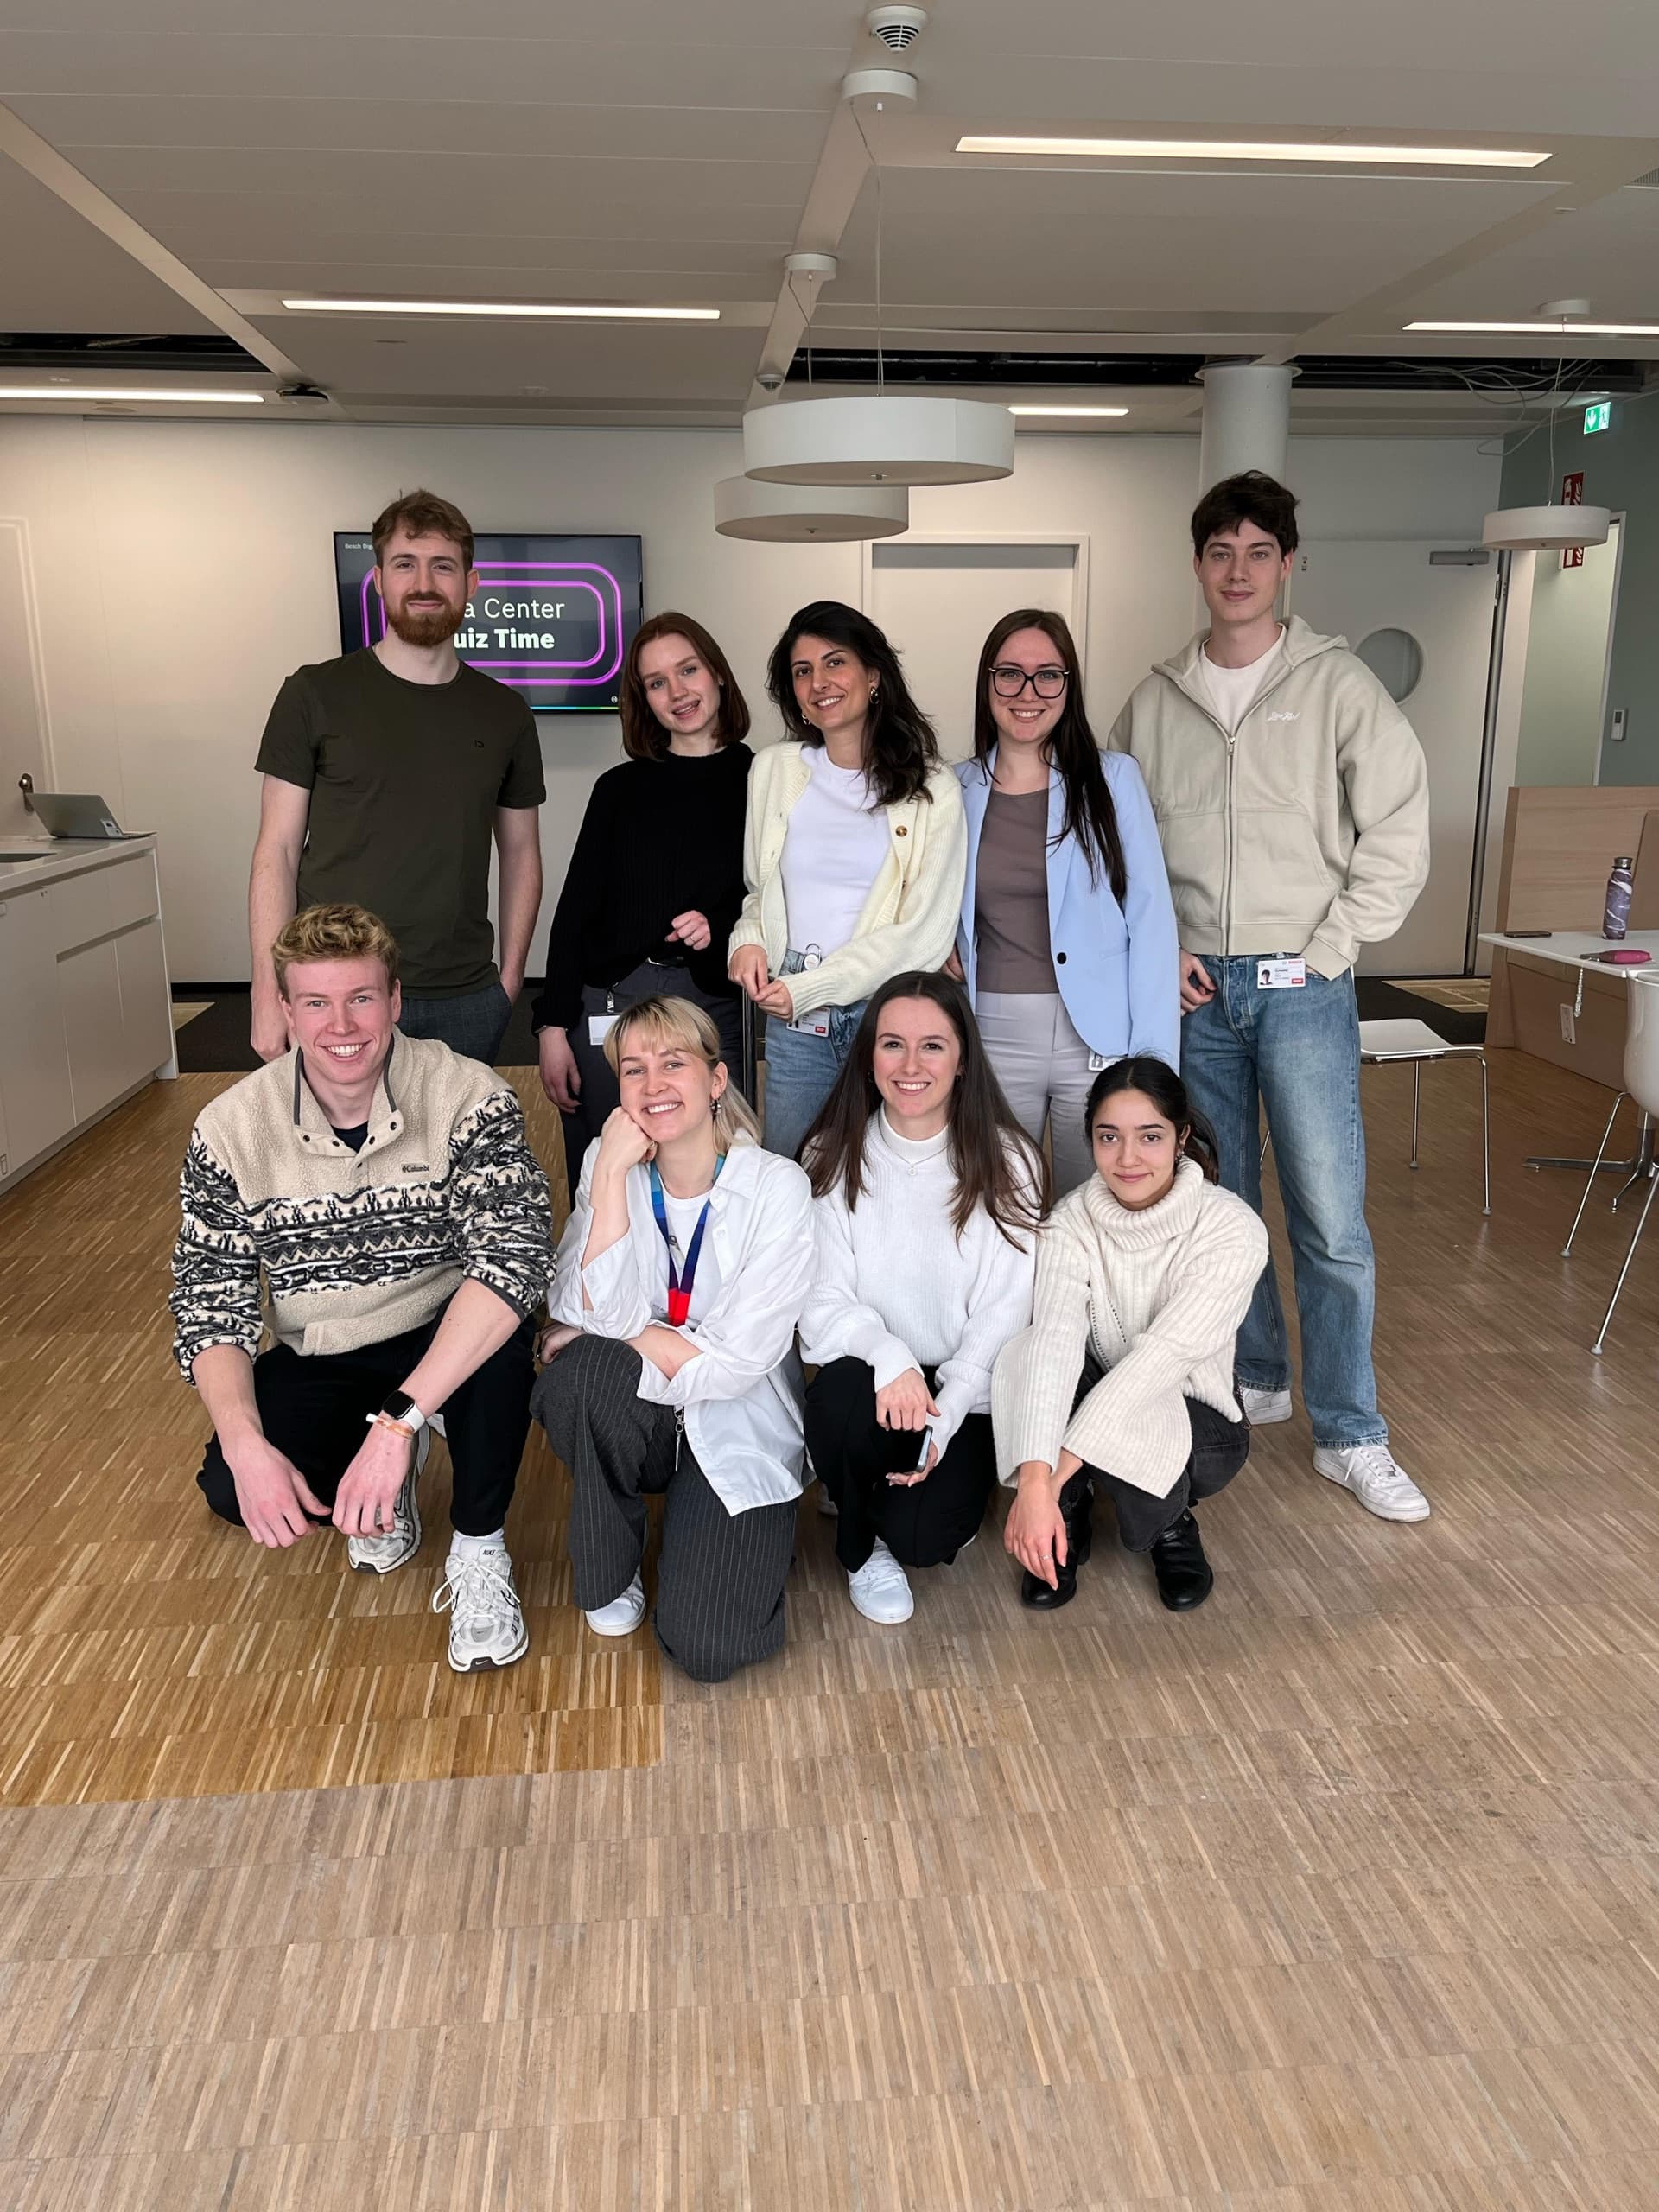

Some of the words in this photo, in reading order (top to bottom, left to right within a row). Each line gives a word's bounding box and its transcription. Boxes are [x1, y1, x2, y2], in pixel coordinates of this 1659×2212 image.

[484, 598, 565, 619] Center
[454, 627, 489, 648] uiz
[494, 627, 555, 649] Time
